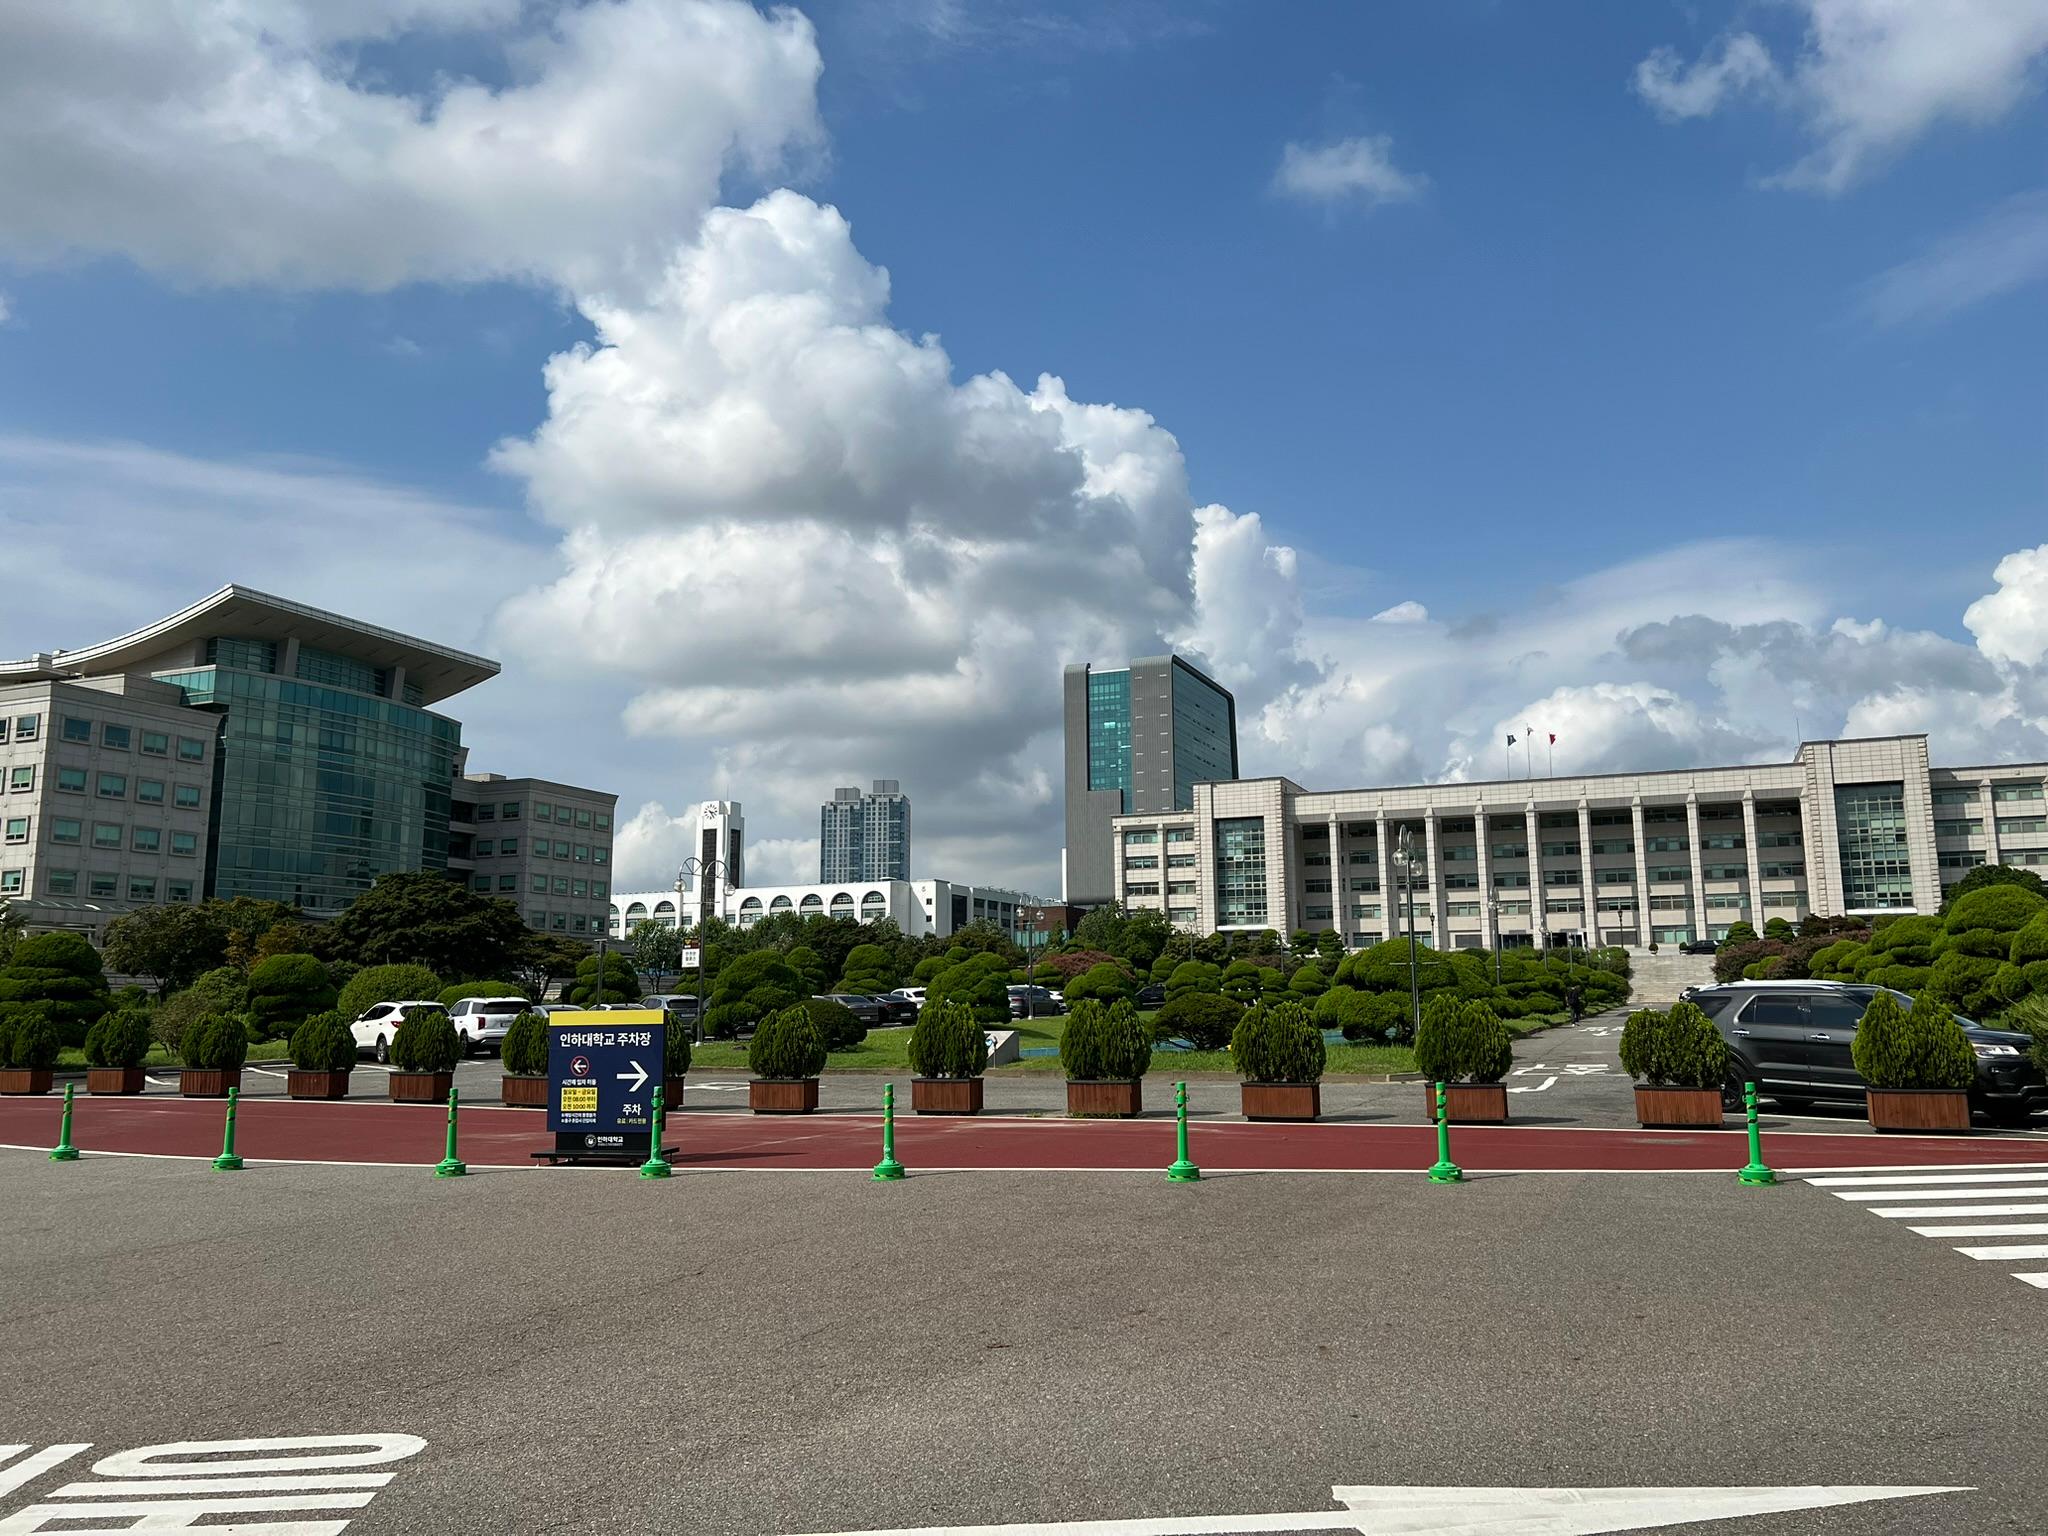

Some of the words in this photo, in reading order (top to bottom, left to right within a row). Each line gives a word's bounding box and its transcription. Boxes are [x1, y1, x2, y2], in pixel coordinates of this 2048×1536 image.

[560, 1032, 615, 1047] 인하대학교
[617, 1032, 651, 1047] 주차장
[622, 1103, 642, 1116] 주차
